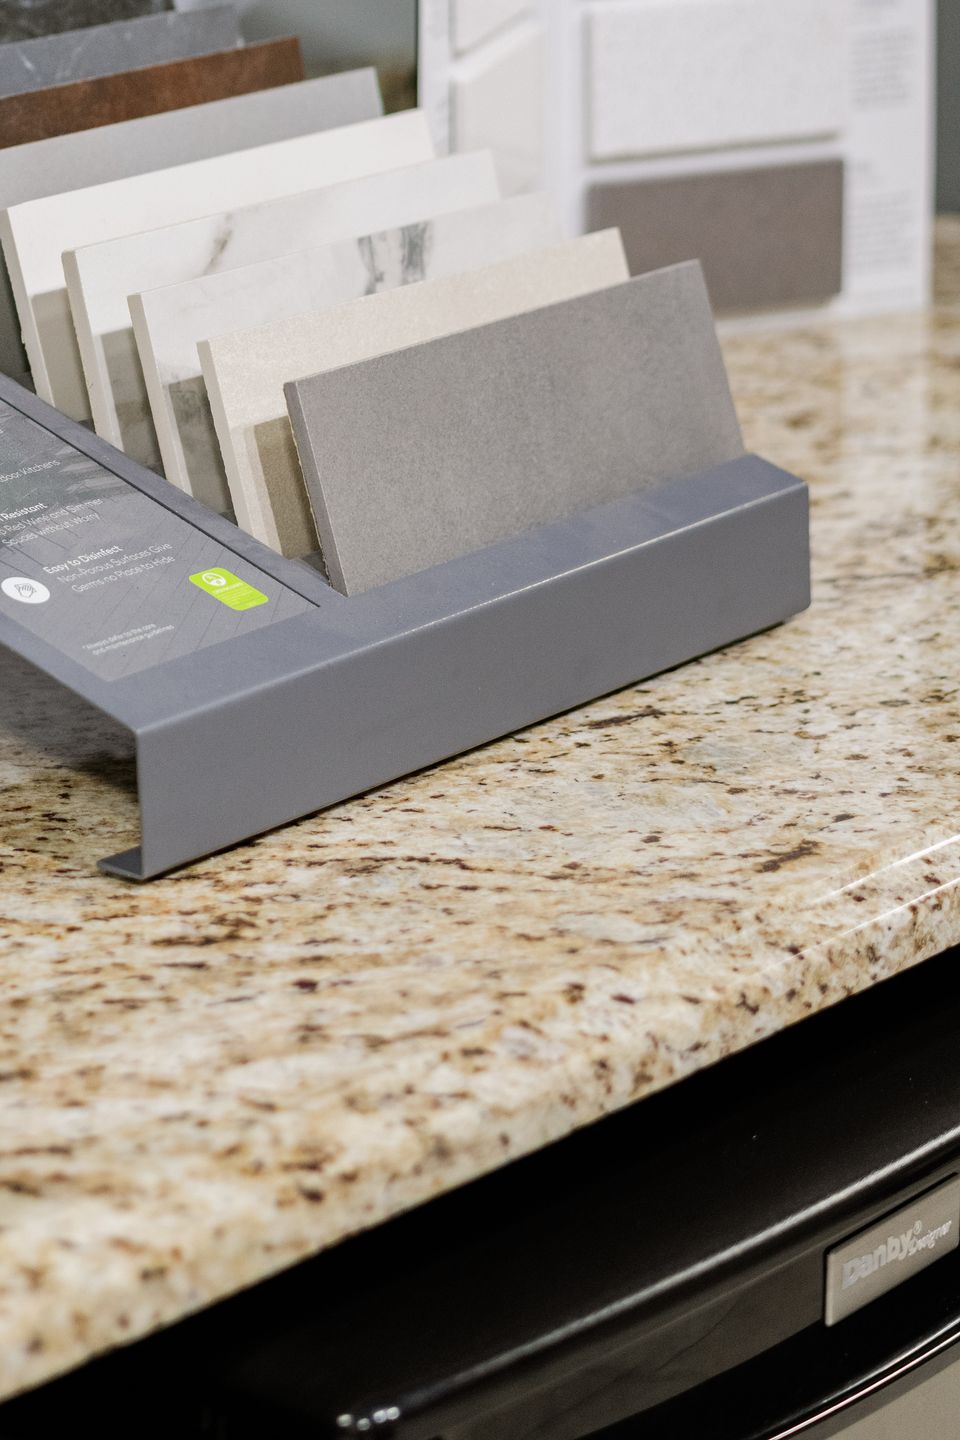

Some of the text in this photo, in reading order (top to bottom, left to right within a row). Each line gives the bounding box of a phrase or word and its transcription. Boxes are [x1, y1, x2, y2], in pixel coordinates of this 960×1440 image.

[17, 460, 62, 474] Kitchens
[0, 502, 49, 520] Resistant
[2, 521, 27, 532] Red
[20, 515, 52, 526] Wine
[47, 508, 71, 519] and
[63, 498, 106, 513] Simmer
[0, 513, 104, 546] Sauces without Worry
[41, 563, 72, 574] Easy
[76, 544, 125, 562] Disinfect
[107, 550, 154, 566] Surfaces
[145, 543, 174, 554] Give
[103, 574, 119, 582] no
[112, 566, 145, 578] Place
[148, 555, 177, 566] Hide
